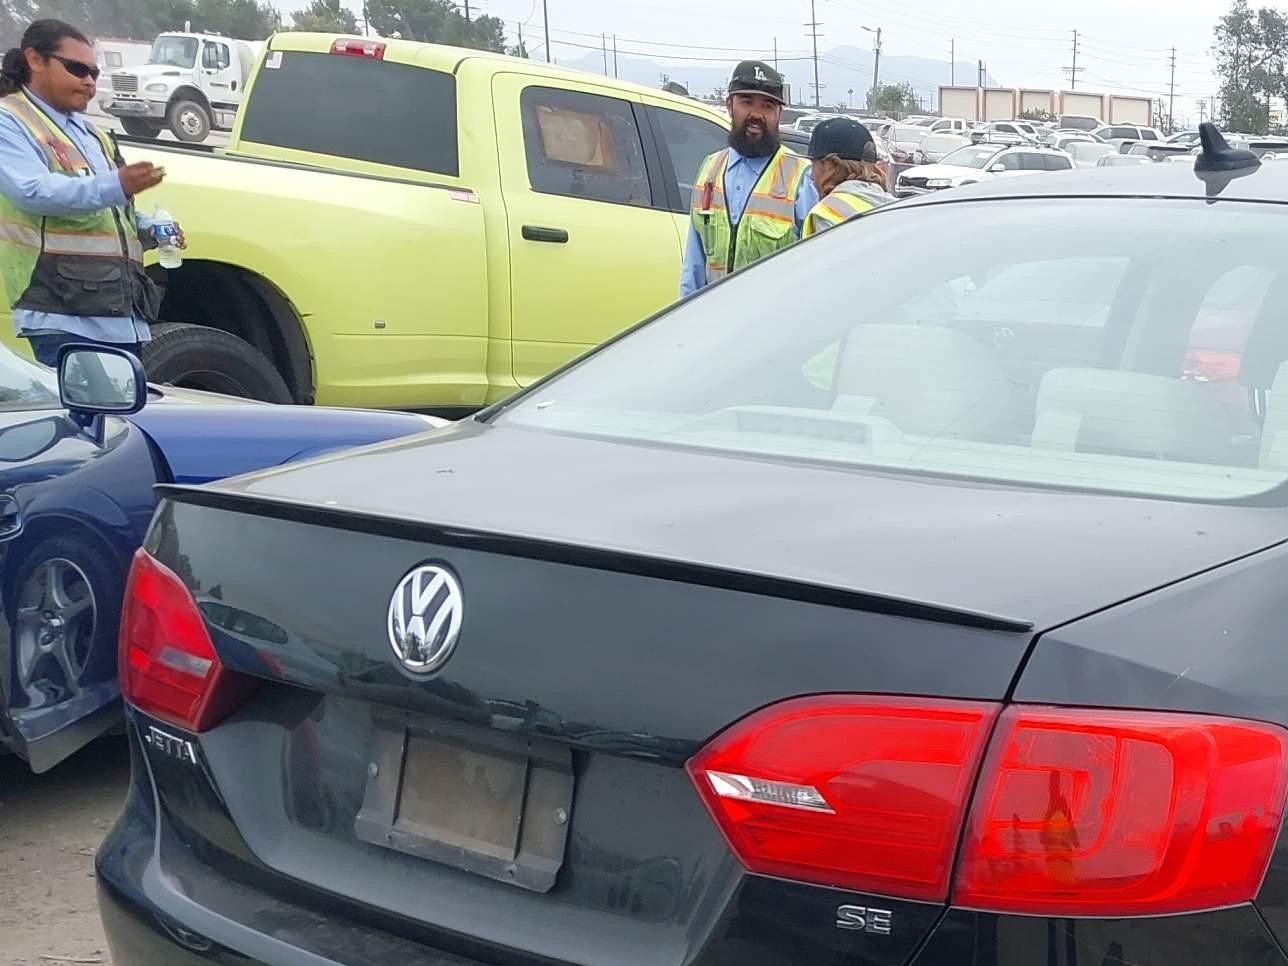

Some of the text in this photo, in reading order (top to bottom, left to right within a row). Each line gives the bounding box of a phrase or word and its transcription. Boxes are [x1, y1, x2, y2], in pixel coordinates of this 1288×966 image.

[753, 66, 767, 81] LA
[144, 726, 197, 764] JETTA
[836, 904, 893, 935] SE
